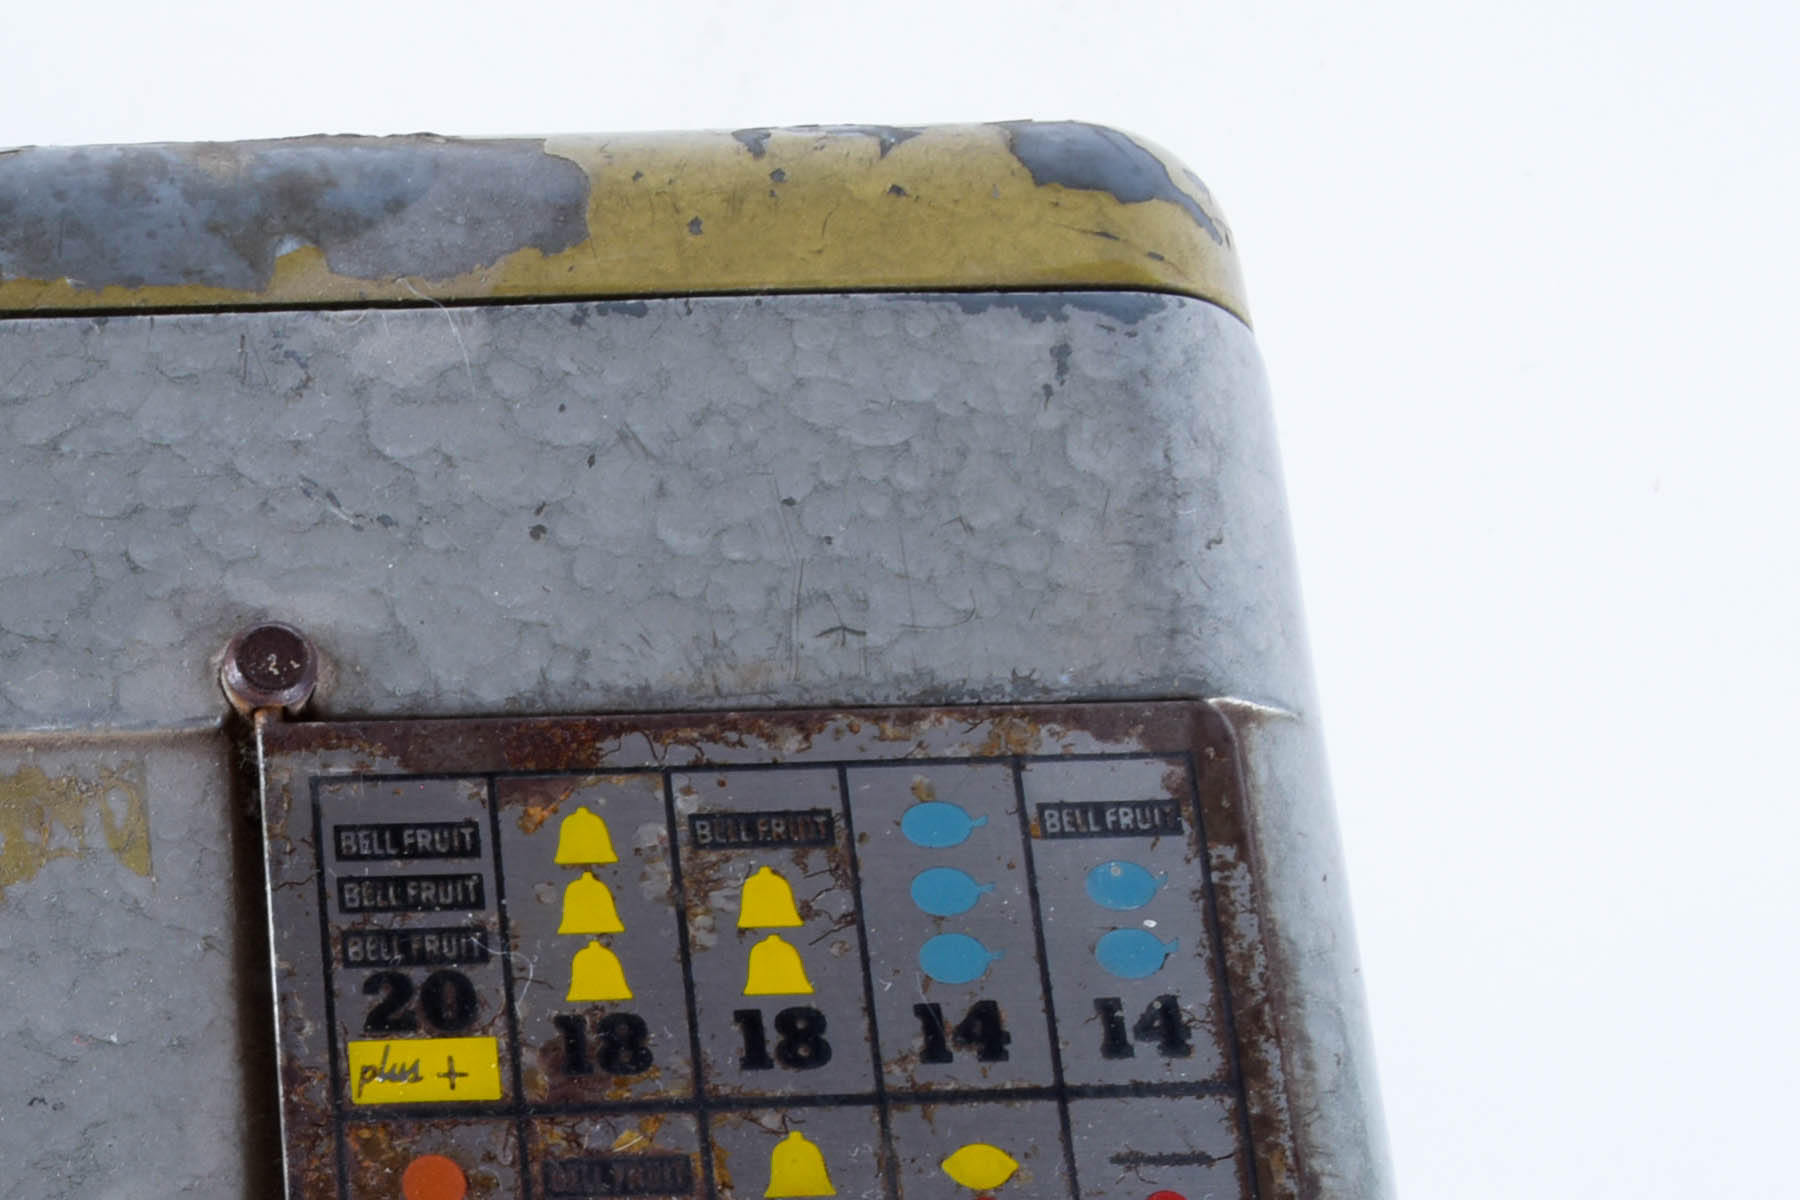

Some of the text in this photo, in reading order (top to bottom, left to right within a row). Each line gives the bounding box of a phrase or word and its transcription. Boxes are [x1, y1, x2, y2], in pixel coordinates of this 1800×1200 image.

[339, 826, 475, 856] BELL FRUIT
[1043, 805, 1175, 833] BELL FRUIT
[343, 878, 479, 908] BELL FRUIT
[347, 932, 483, 962] BELL FRUIT
[362, 968, 480, 1034] 20
[1094, 994, 1193, 1060] 14
[554, 1011, 654, 1076] 18
[733, 1006, 833, 1071] 18
[913, 1000, 1011, 1065] 14
[358, 1044, 424, 1098] plus
